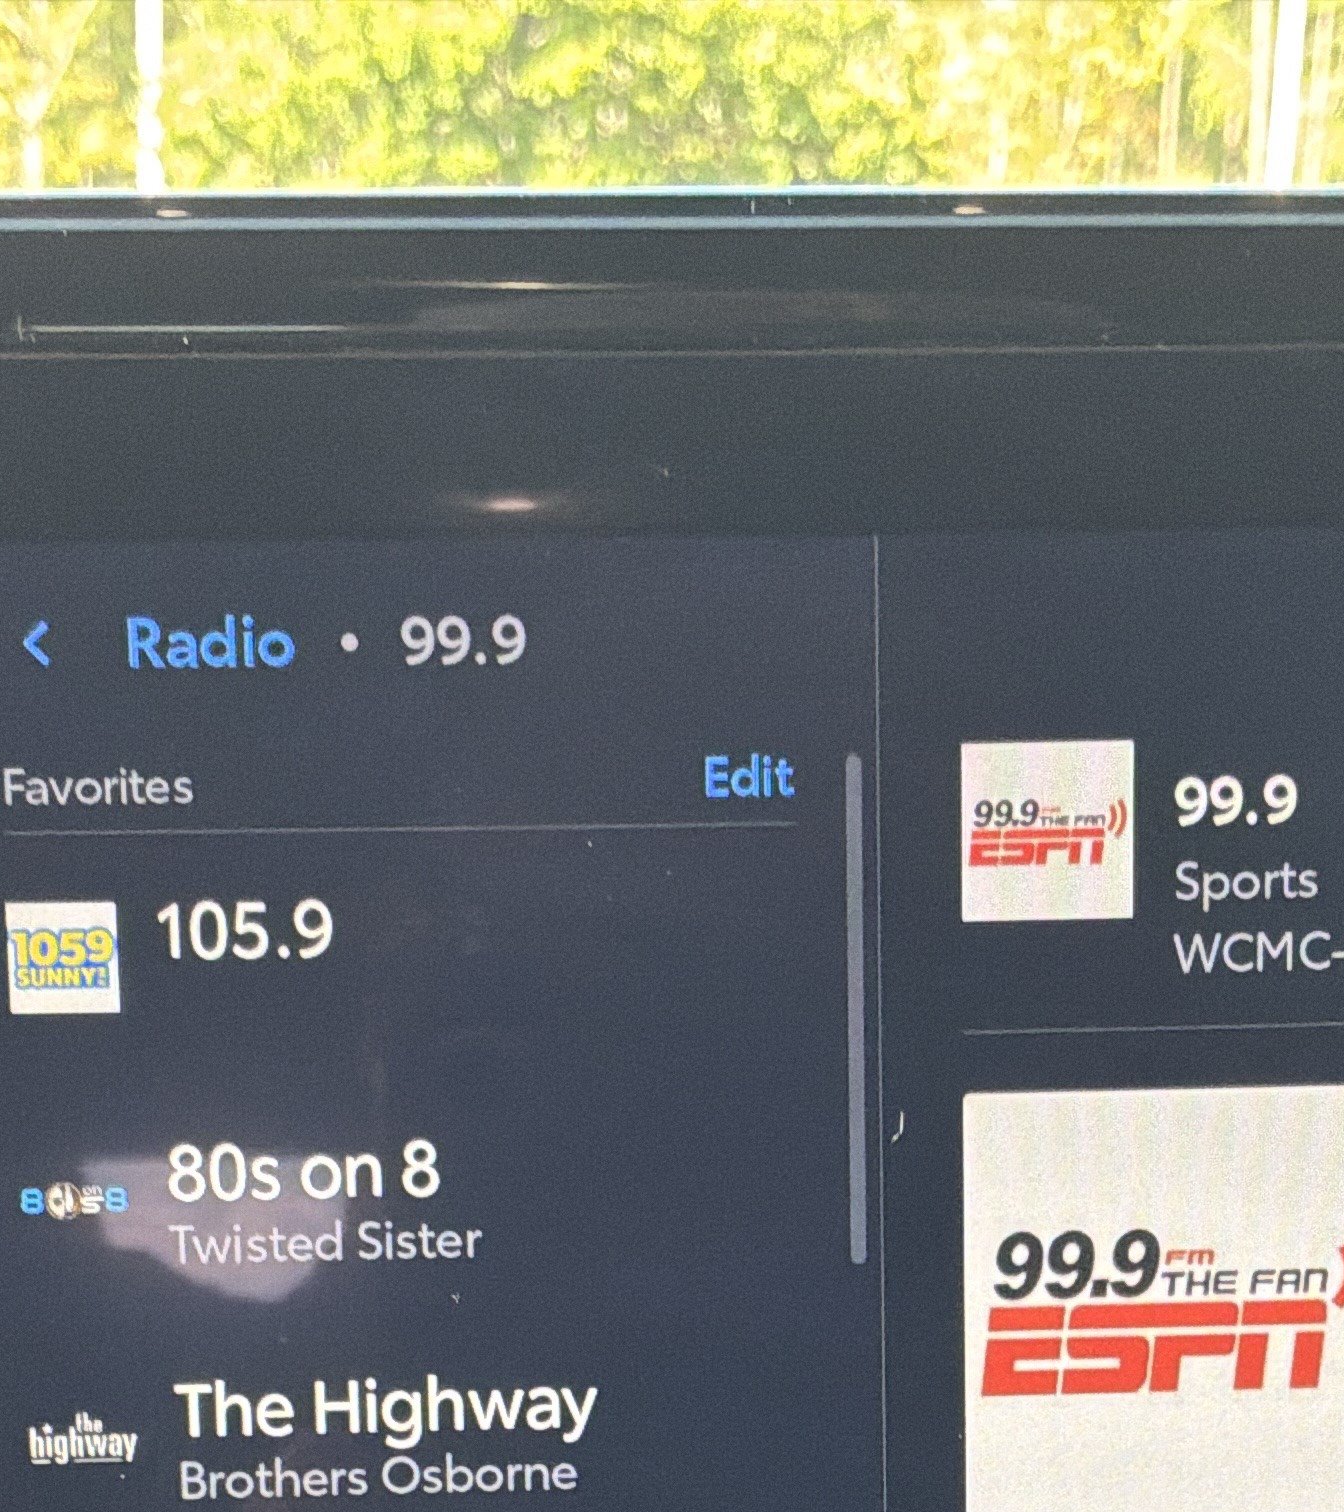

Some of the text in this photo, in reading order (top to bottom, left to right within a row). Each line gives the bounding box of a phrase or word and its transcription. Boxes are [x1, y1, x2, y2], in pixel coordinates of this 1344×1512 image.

[125, 612, 528, 670] Radio 99.9
[2, 766, 195, 807] Favorites
[703, 751, 797, 799] Edit
[972, 798, 1041, 828] 99.9
[1173, 773, 1299, 828] 99.9
[968, 827, 1105, 867] ESPN
[1173, 859, 1320, 914] Sports
[9, 928, 115, 967] 1059
[156, 897, 334, 962] 105.9
[165, 1138, 442, 1203] 80s on 8
[167, 1219, 484, 1266] Twisted Sister
[993, 1228, 1161, 1300] 99.9
[1165, 1248, 1215, 1265] FM
[1162, 1267, 1329, 1297] THE FAN
[981, 1299, 1328, 1397] ESPN
[172, 1372, 599, 1450] The Highway
[29, 1422, 138, 1465] highway
[178, 1452, 579, 1501] Brothers Osborne
